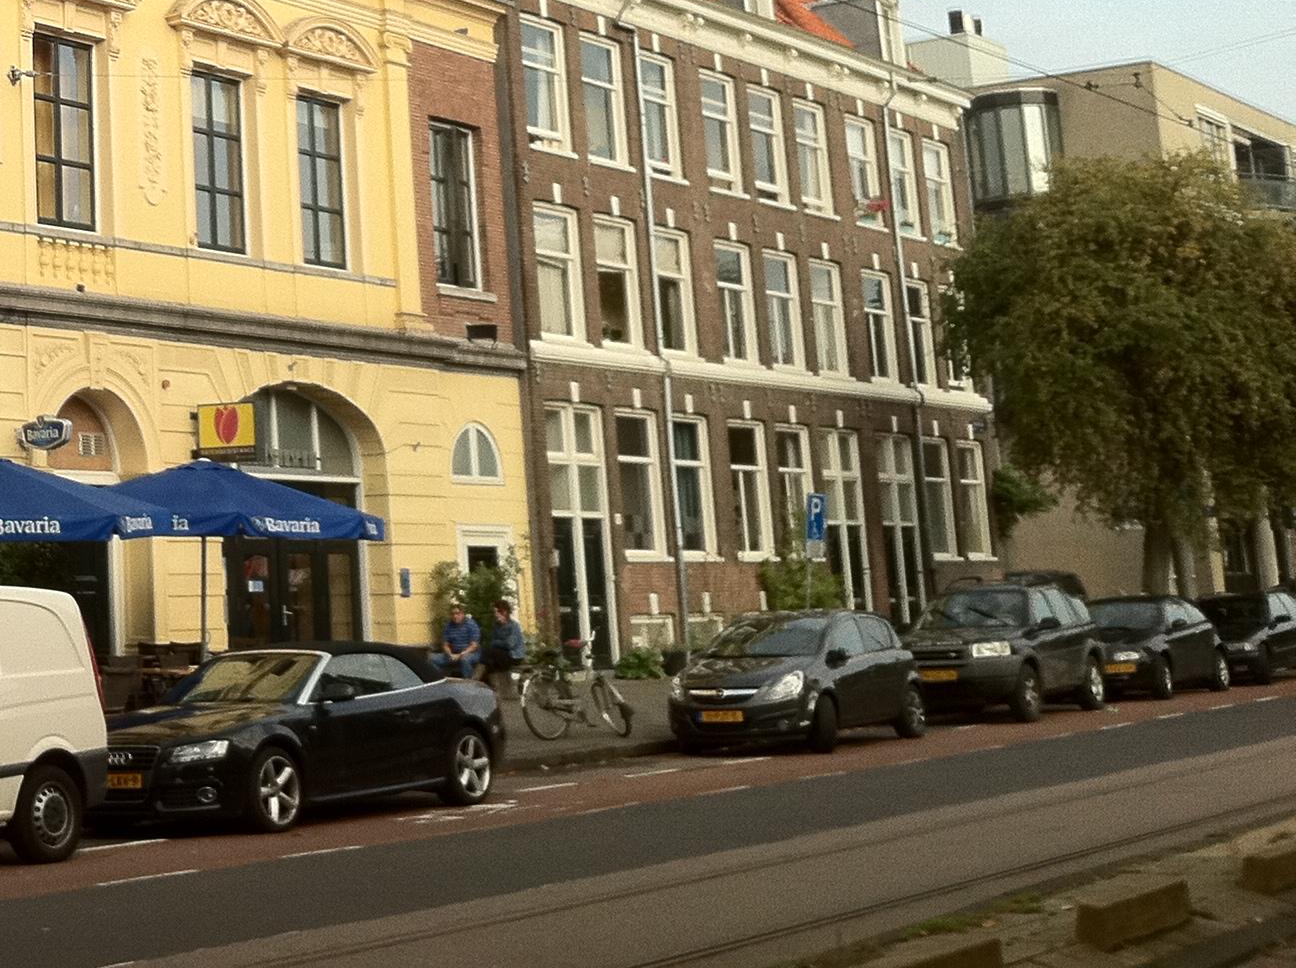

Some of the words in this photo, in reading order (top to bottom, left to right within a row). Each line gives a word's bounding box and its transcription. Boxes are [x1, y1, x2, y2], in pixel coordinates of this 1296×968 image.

[26, 426, 59, 441] Bavaria
[811, 497, 821, 520] P
[264, 516, 321, 533] Bavaria
